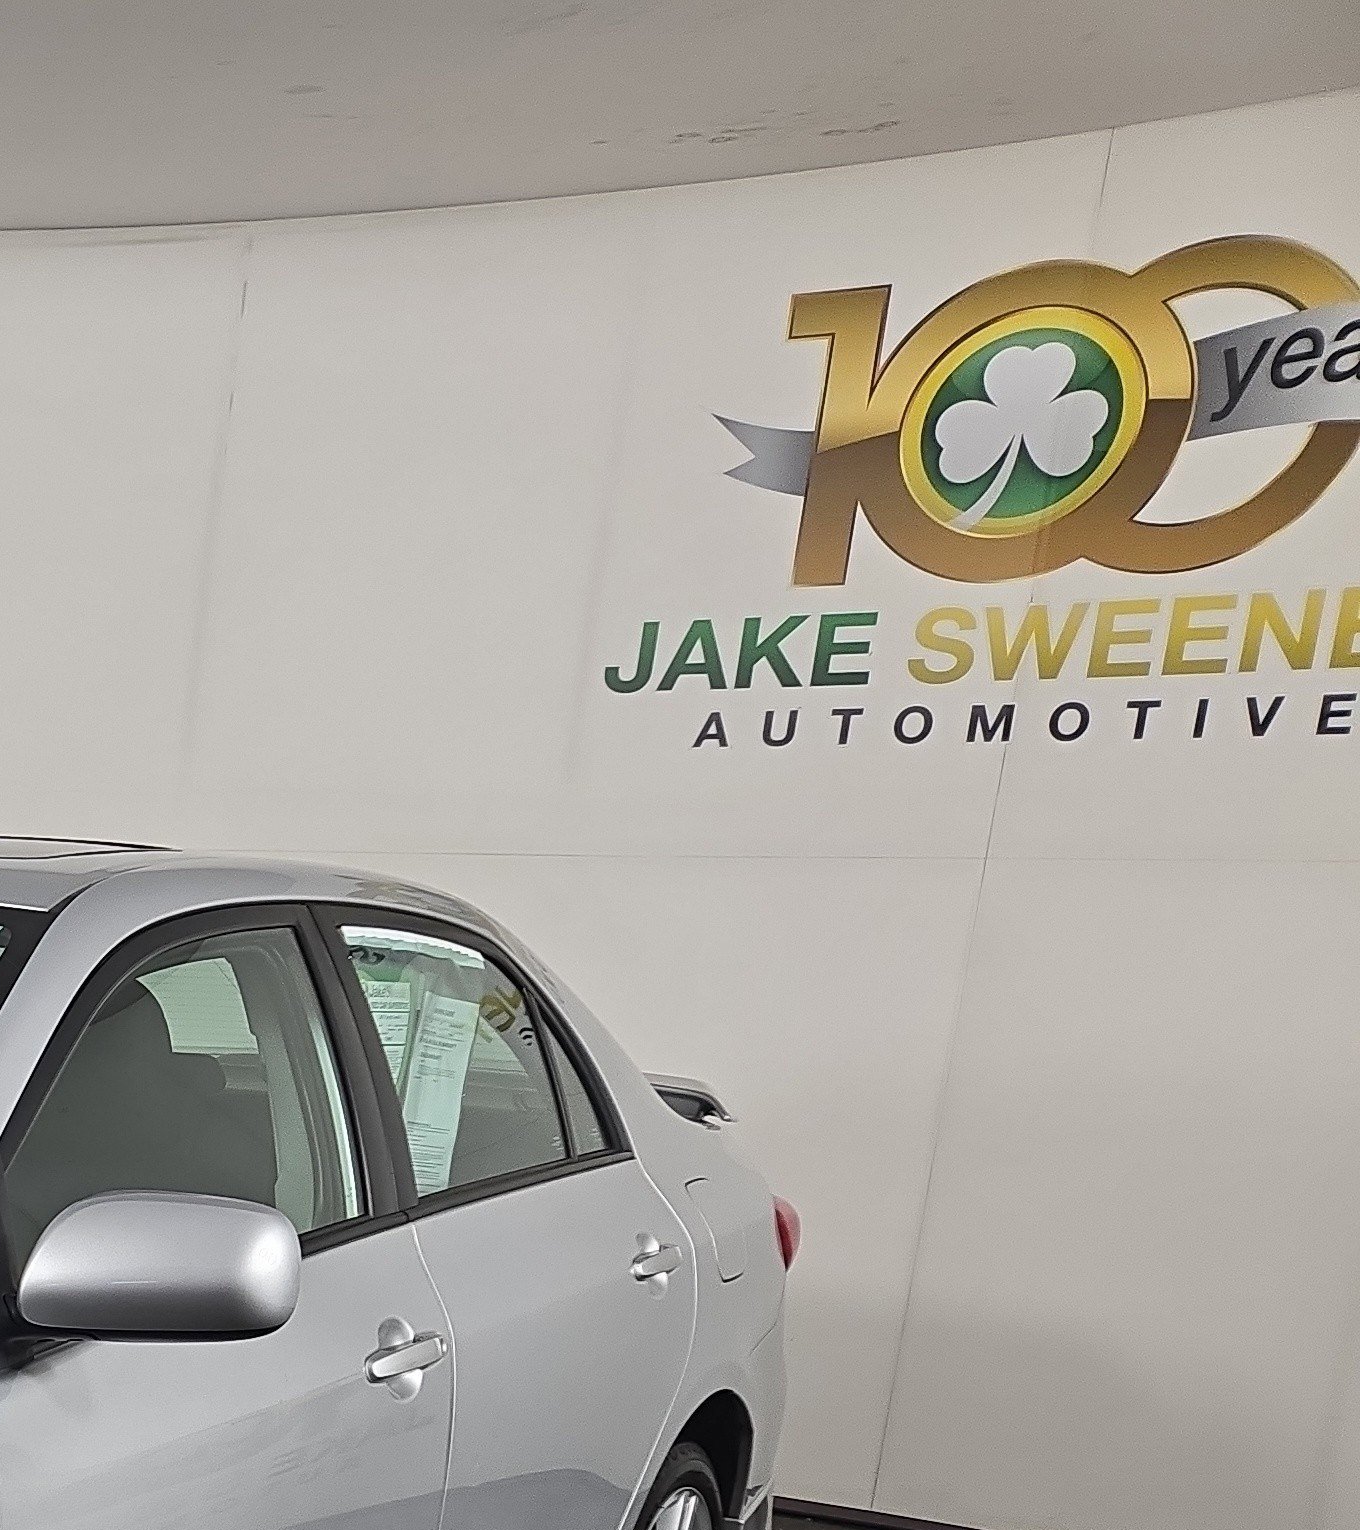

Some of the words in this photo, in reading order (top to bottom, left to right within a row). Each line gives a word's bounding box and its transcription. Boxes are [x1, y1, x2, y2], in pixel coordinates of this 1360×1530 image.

[787, 233, 1360, 588] 100
[603, 611, 879, 694] JAKE
[691, 692, 1358, 750] AUTOMOTIVE
